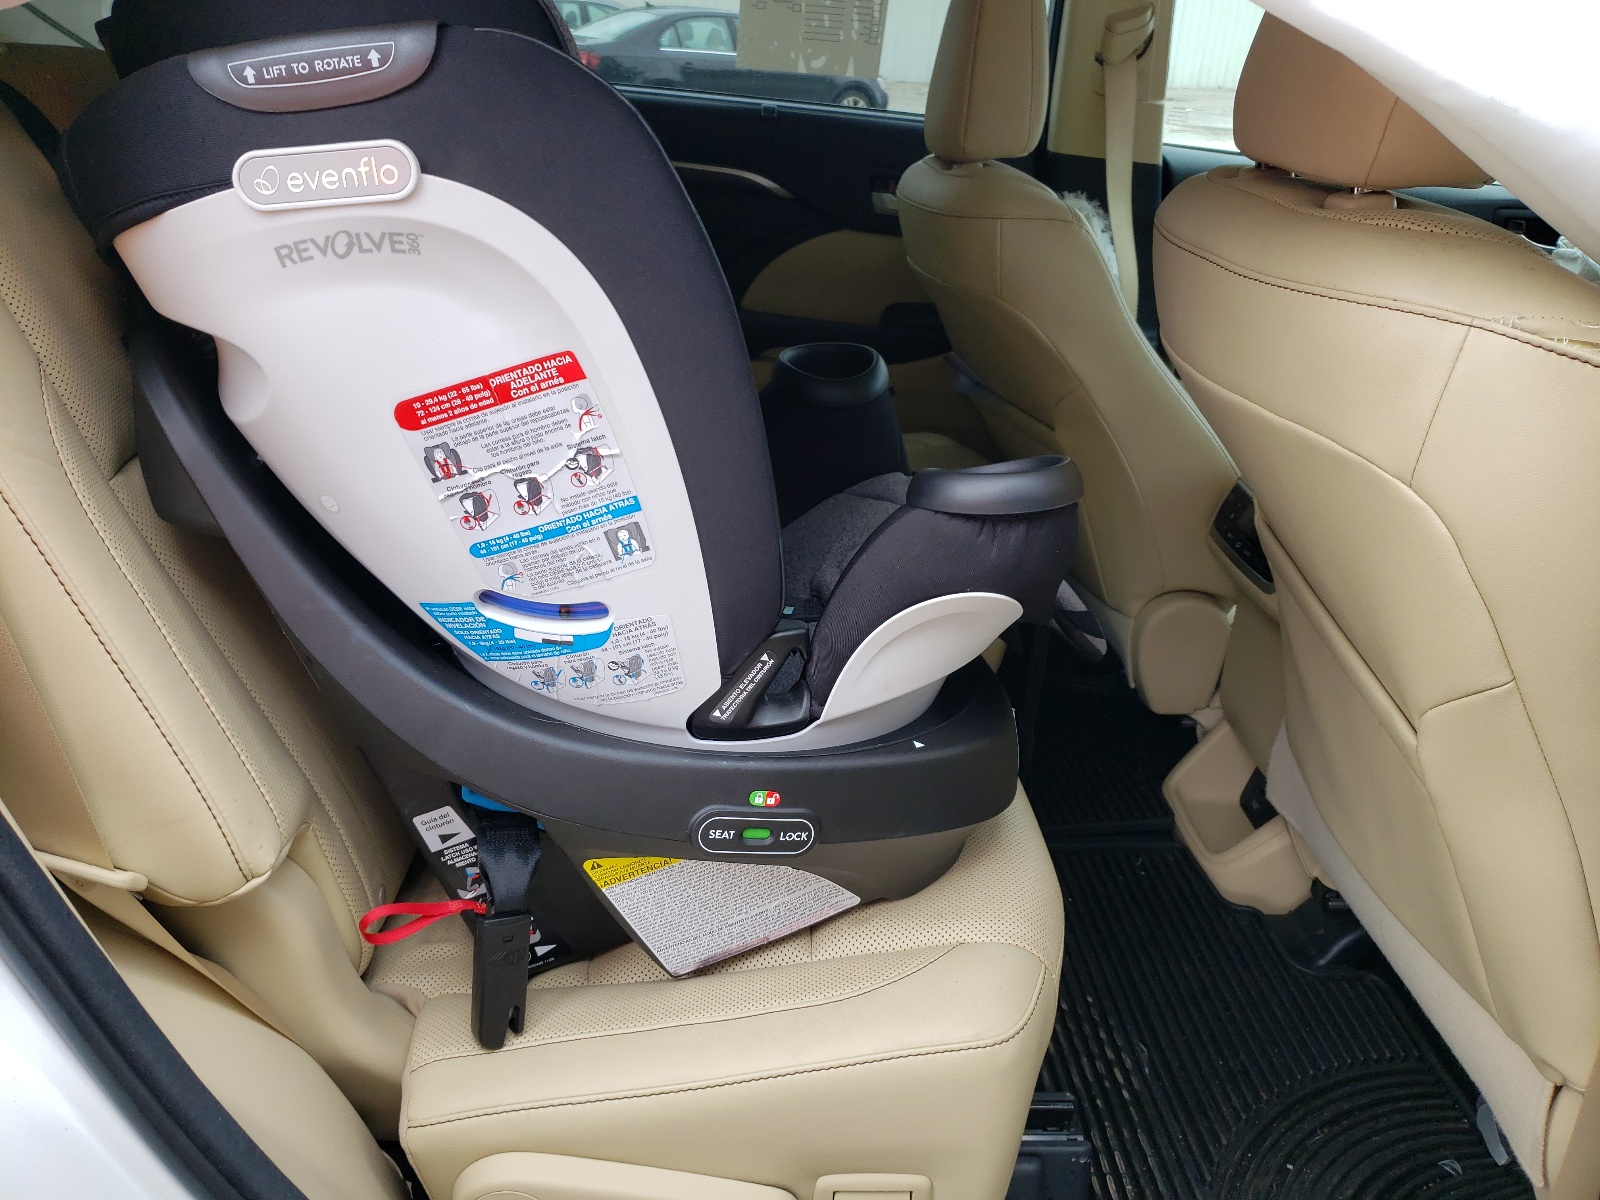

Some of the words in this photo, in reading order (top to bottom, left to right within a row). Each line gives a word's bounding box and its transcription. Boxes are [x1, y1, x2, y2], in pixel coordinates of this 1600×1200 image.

[263, 64, 287, 79] LIFT
[291, 62, 309, 76] TO
[314, 55, 362, 72] ROTATE
[286, 156, 399, 193] evenflo
[273, 229, 407, 269] REVOLVE
[488, 362, 543, 386] ORIENTADO
[543, 354, 572, 370] HACIA
[508, 367, 558, 389] ADELANTE
[510, 385, 529, 398] Con
[529, 382, 538, 392] el
[539, 374, 564, 389] arnés
[537, 513, 582, 533] ORIENTADO
[582, 505, 608, 519] HACIA
[607, 495, 635, 511] ATRÁS
[565, 522, 581, 533] Con
[582, 519, 590, 527] el
[590, 512, 612, 524] arnés
[612, 627, 633, 637] HACIA
[613, 616, 652, 631] ORIENTADO
[721, 688, 740, 710] ASIENTO
[738, 662, 762, 689] ELEVADOR
[720, 690, 748, 720] TRAYECTORIA
[745, 682, 756, 691] DEL
[420, 816, 437, 825] Guía
[438, 811, 449, 819] del
[425, 818, 454, 831] cinturón
[708, 829, 735, 840] SEAT
[780, 831, 809, 841] LOCK
[440, 851, 460, 861] LATCH
[460, 845, 473, 855] USO
[443, 842, 469, 854] SISTEMA
[600, 857, 671, 887] ¡ADVERTENCIA!
